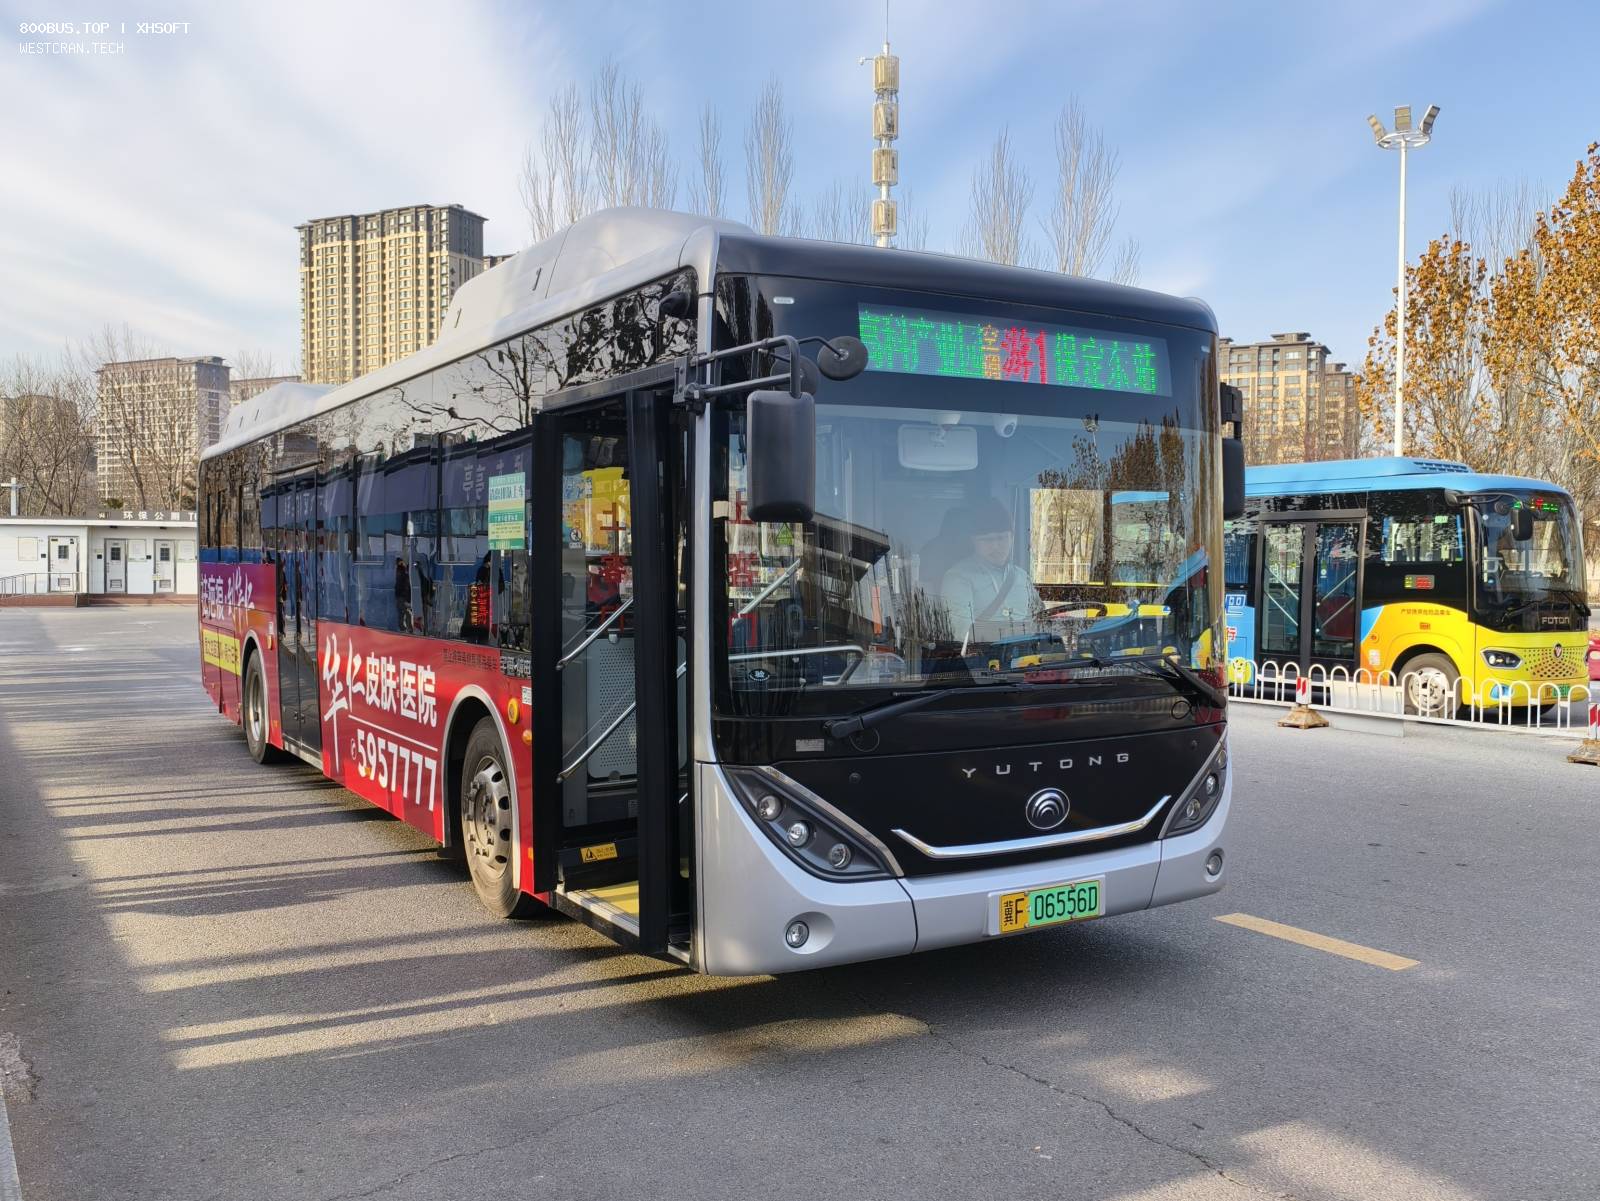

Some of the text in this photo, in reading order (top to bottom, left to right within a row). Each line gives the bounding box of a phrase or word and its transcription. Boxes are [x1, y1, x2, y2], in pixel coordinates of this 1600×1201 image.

[1541, 616, 1570, 625] FOTON
[357, 728, 437, 812] 5957777
[962, 753, 1129, 778] YUTONG
[1034, 886, 1097, 920] 06556D
